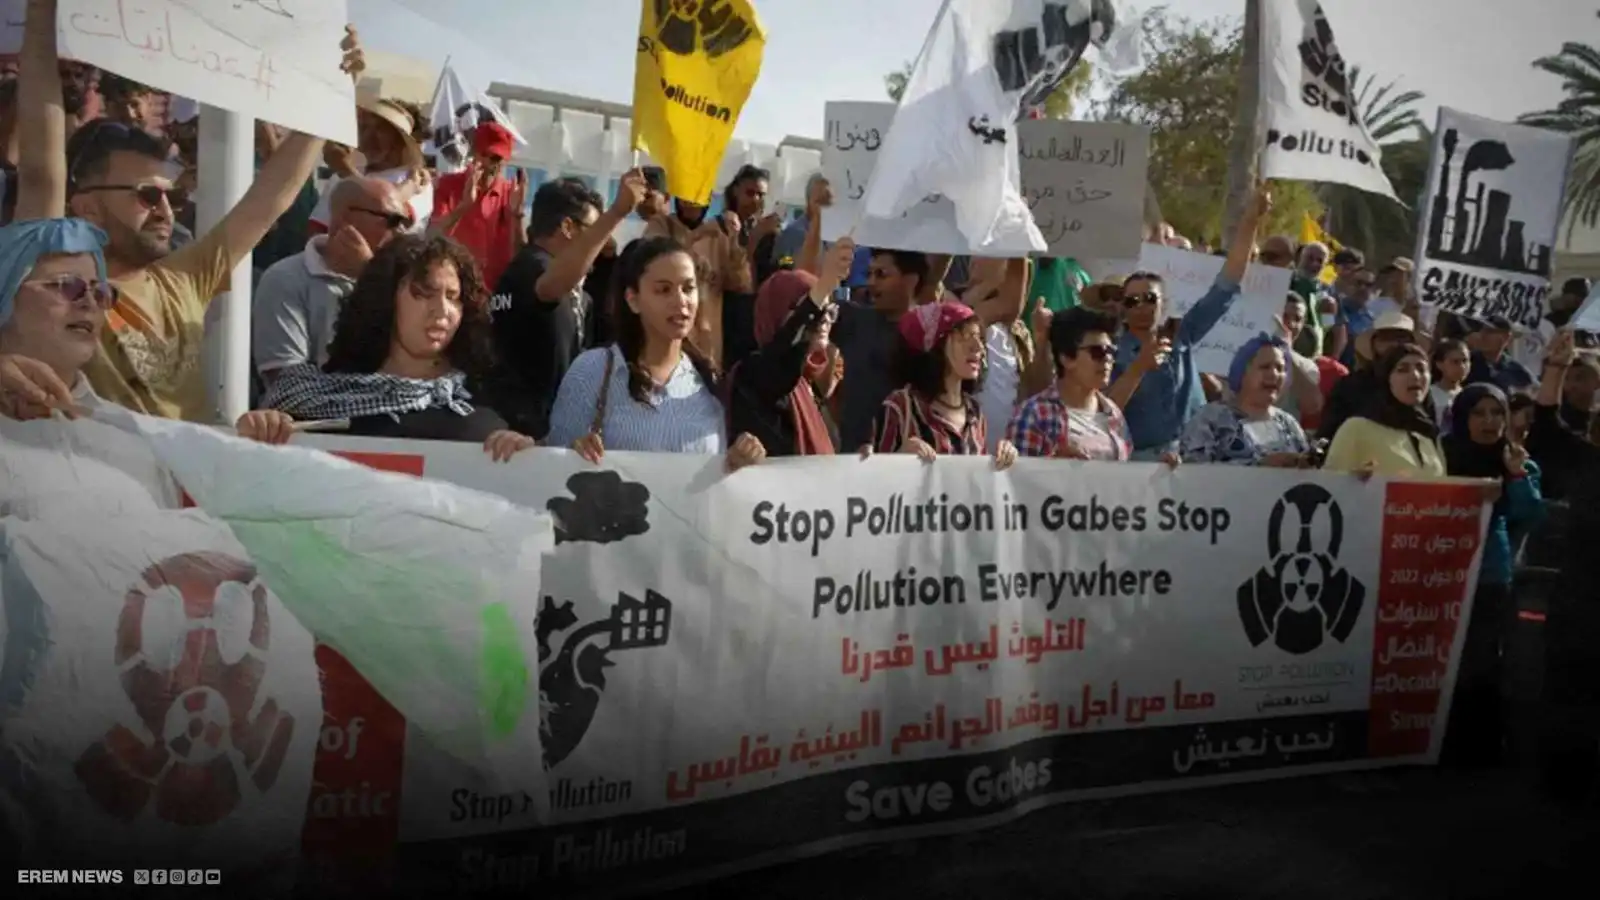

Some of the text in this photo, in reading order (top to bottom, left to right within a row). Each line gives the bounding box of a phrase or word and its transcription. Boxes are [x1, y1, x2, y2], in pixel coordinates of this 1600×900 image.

[1266, 129, 1376, 169] Pollutio
[749, 493, 1231, 556] Stop Pollution in Gabes Stop
[1391, 532, 1420, 550] 2012
[811, 560, 1173, 618] Pollution Everywhere
[841, 616, 1087, 683] التلوث ليس قدرنا
[1125, 695, 1167, 723] من
[1174, 678, 1216, 712] معا
[321, 715, 367, 761] of
[891, 697, 1002, 756] الجرائم
[1172, 721, 1336, 774] نحب نعيش
[666, 734, 783, 801] بقابس
[450, 787, 513, 825] Stop
[845, 780, 955, 823] Save
